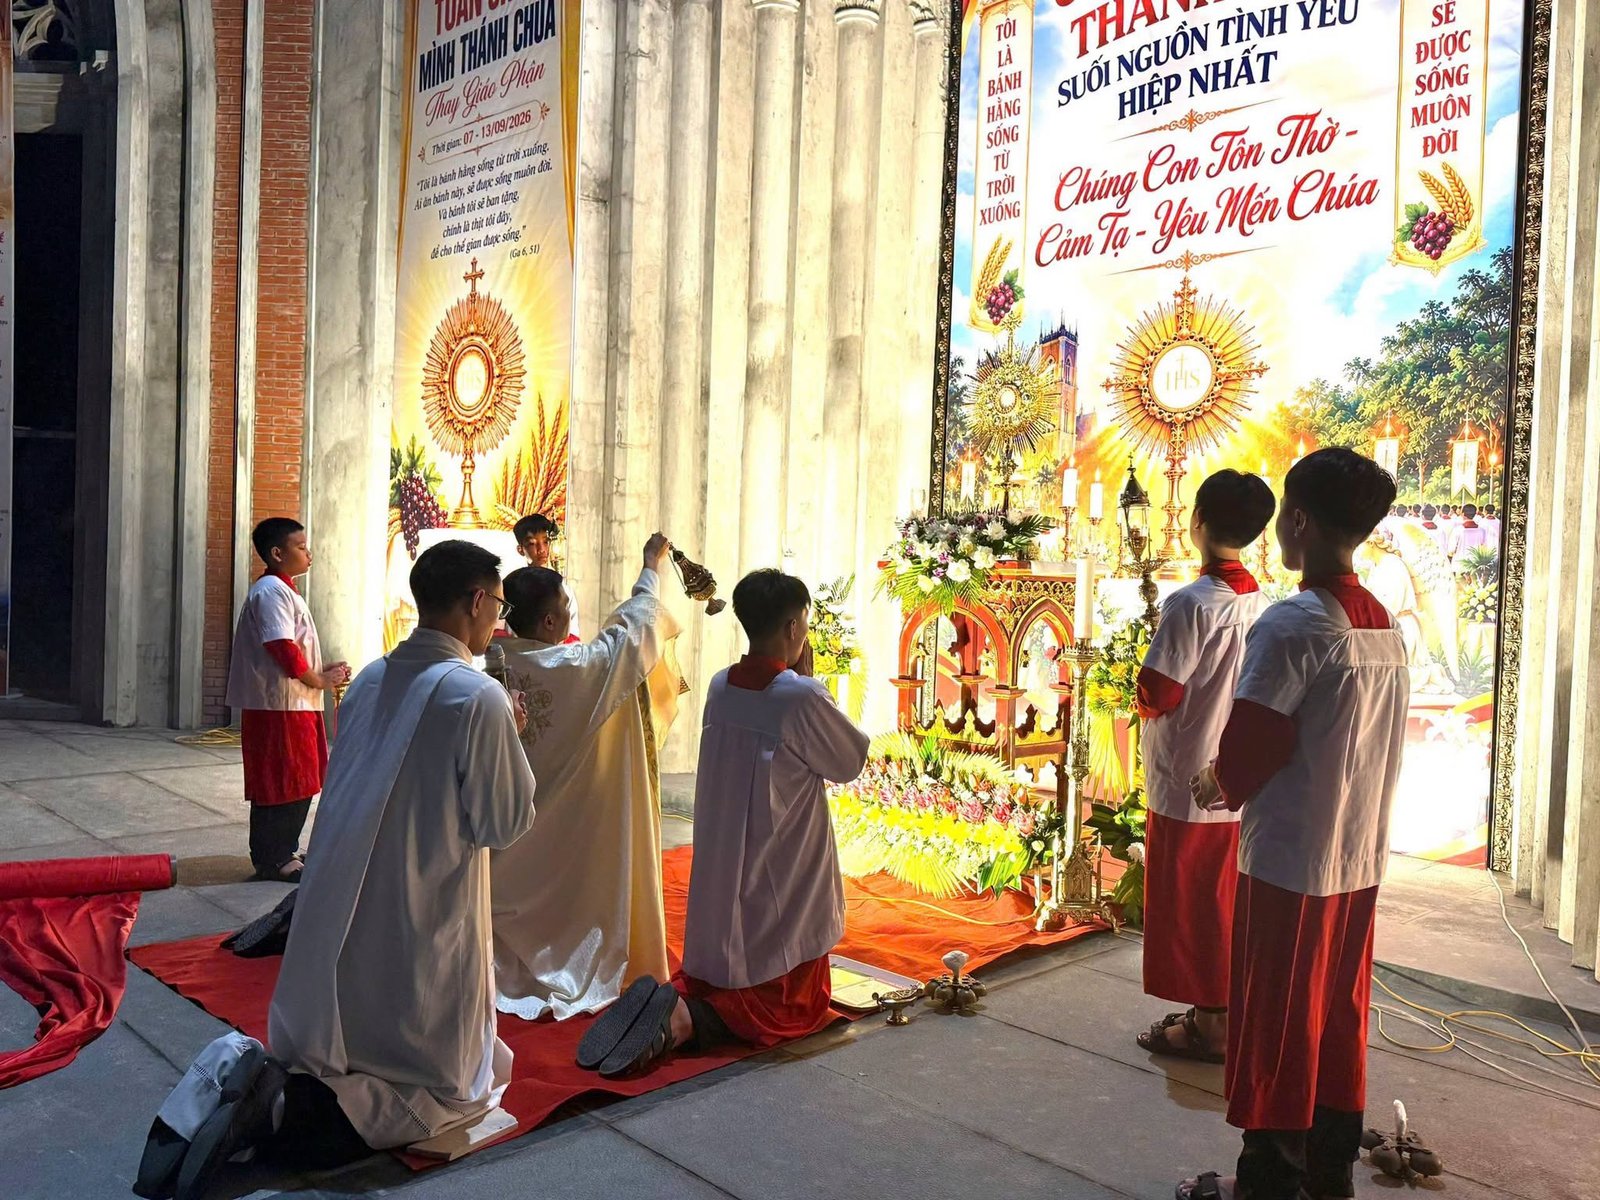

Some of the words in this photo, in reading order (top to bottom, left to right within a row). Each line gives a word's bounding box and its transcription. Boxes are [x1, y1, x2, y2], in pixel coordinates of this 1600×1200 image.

[995, 18, 1017, 42] TÔI
[419, 40, 455, 92] MÌNH
[460, 15, 509, 75] THÁNH
[997, 44, 1013, 68] LÀ
[1057, 54, 1111, 108] SUỐI
[1117, 20, 1210, 82] NGUỒN
[1217, 4, 1289, 47] TÌNH
[1415, 30, 1471, 65] ĐƯỢC
[425, 83, 460, 127] Thay
[462, 75, 496, 118] Giáo
[501, 58, 546, 98] Phận
[987, 71, 1022, 97] BÁNH
[1117, 73, 1182, 121] HIỆP
[1188, 44, 1278, 98] NHẤT
[1415, 62, 1470, 96] SỐNG
[987, 97, 1021, 124] HẰNG
[1411, 94, 1472, 128] MUÔN
[463, 130, 474, 145] 07
[481, 110, 531, 139] 13/09/2026
[986, 122, 1019, 149] SỐNG
[1422, 128, 1458, 158] ĐỜI
[431, 176, 438, 188] là
[439, 169, 457, 185] bánh
[477, 157, 495, 172] sống
[994, 149, 1011, 172] TỪ
[1054, 166, 1139, 212] Chúng
[1142, 144, 1202, 192] Con
[1206, 126, 1266, 179] Tôn
[1271, 108, 1341, 164] Thờ
[1345, 129, 1358, 137] -
[414, 198, 423, 211] Ai
[433, 189, 449, 205] bánh
[476, 178, 494, 191] được
[495, 170, 513, 186] sống
[514, 164, 536, 181] muôn
[987, 174, 1016, 199] TRỜI
[448, 203, 465, 219] bánh
[466, 200, 476, 213] tôi
[486, 195, 500, 210] ban
[979, 198, 1021, 226] XUỐNG
[1035, 222, 1095, 268] Cảm
[1097, 209, 1131, 258] Tạ
[1152, 197, 1209, 255] Yêu
[1215, 183, 1281, 237] Mến
[1286, 169, 1381, 221] Chúa
[442, 222, 462, 238] chính
[463, 221, 470, 233] là
[471, 217, 484, 231] thịt
[485, 214, 496, 227] tôi
[440, 244, 453, 256] cho
[466, 237, 482, 254] gian
[483, 233, 501, 247] được
